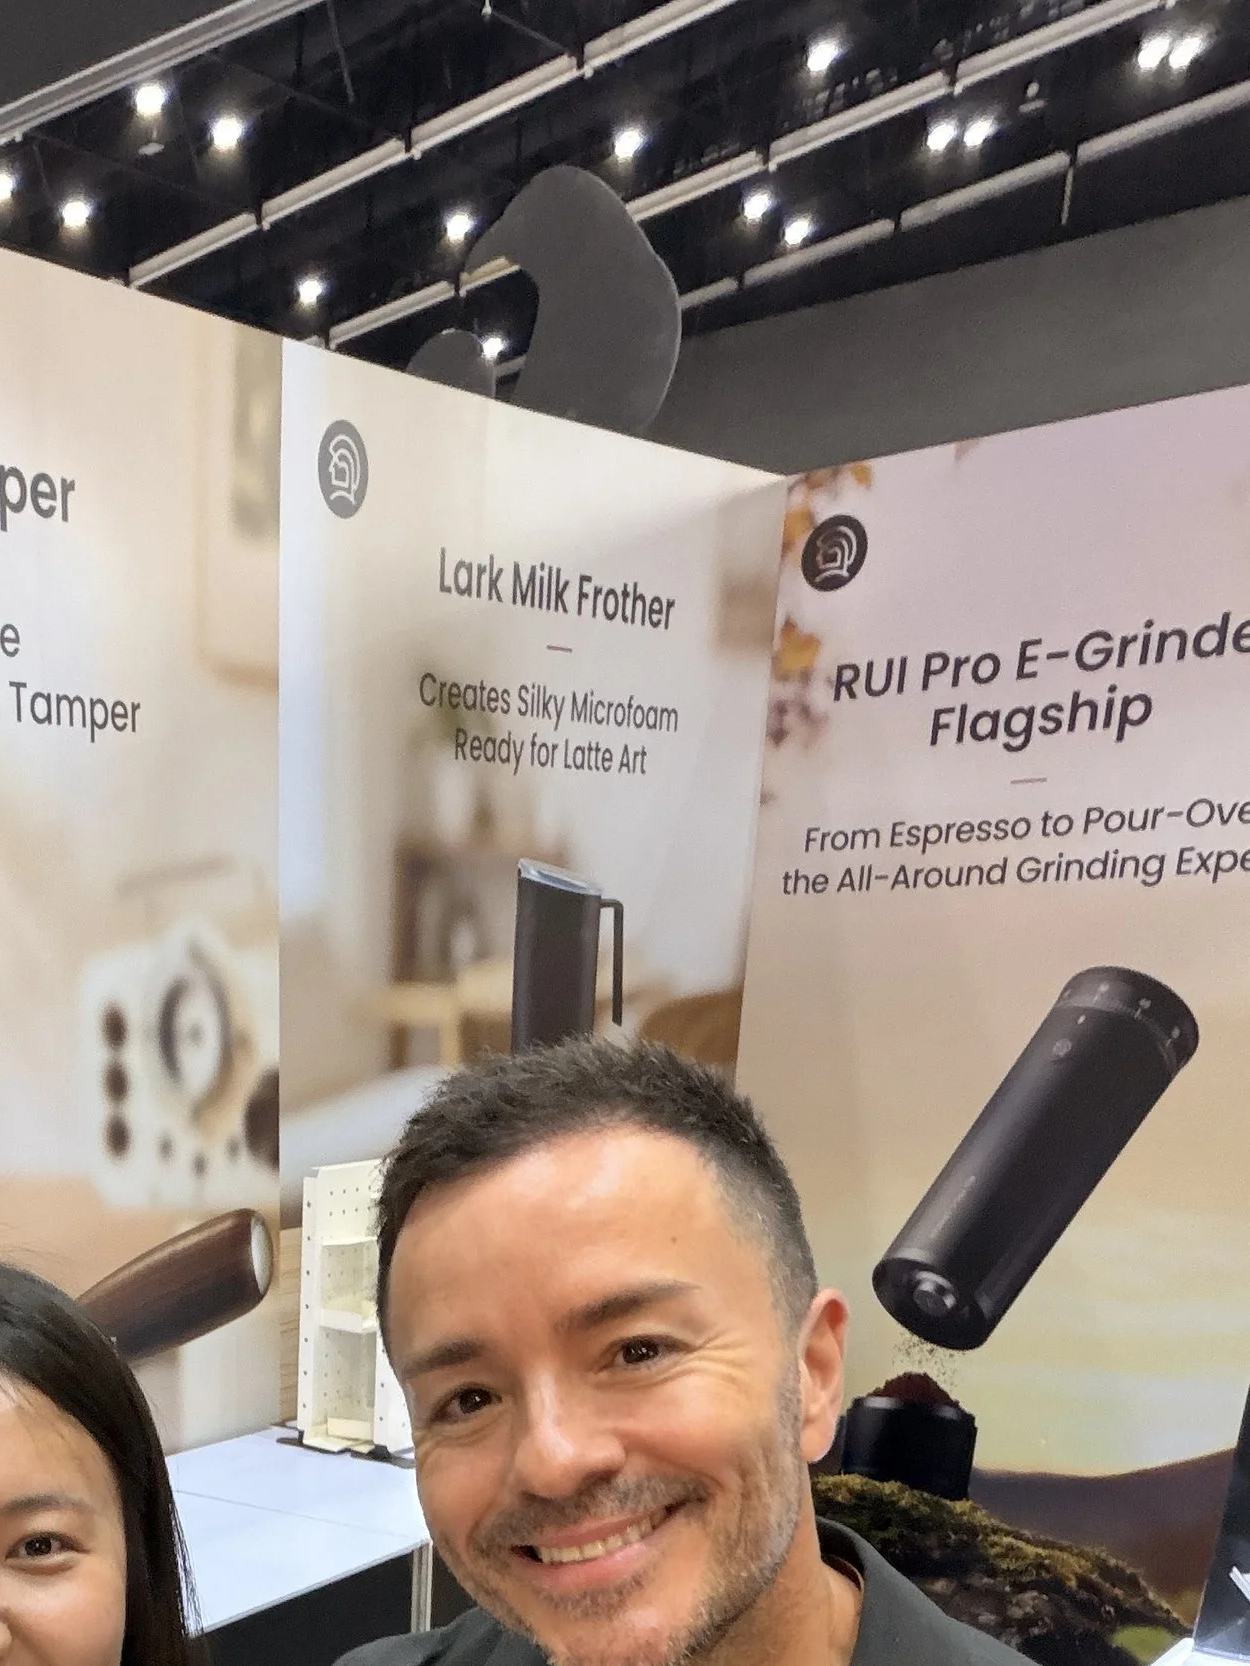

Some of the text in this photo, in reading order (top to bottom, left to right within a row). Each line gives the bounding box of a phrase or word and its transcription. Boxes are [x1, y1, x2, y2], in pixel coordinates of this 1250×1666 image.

[439, 547, 676, 631] Lark Milk Frother
[833, 610, 1250, 703] RUI Pro E-Grinde
[9, 681, 141, 744] Tamper
[419, 672, 679, 733] Creates Silky Microfoam
[929, 683, 1152, 753] Flagship
[454, 727, 648, 776] Ready for Latte Art
[804, 797, 1250, 856] From Espresso to Pour-Ove
[782, 869, 830, 896] the
[836, 856, 1008, 894] All-Around
[1016, 850, 1166, 888] Grinding
